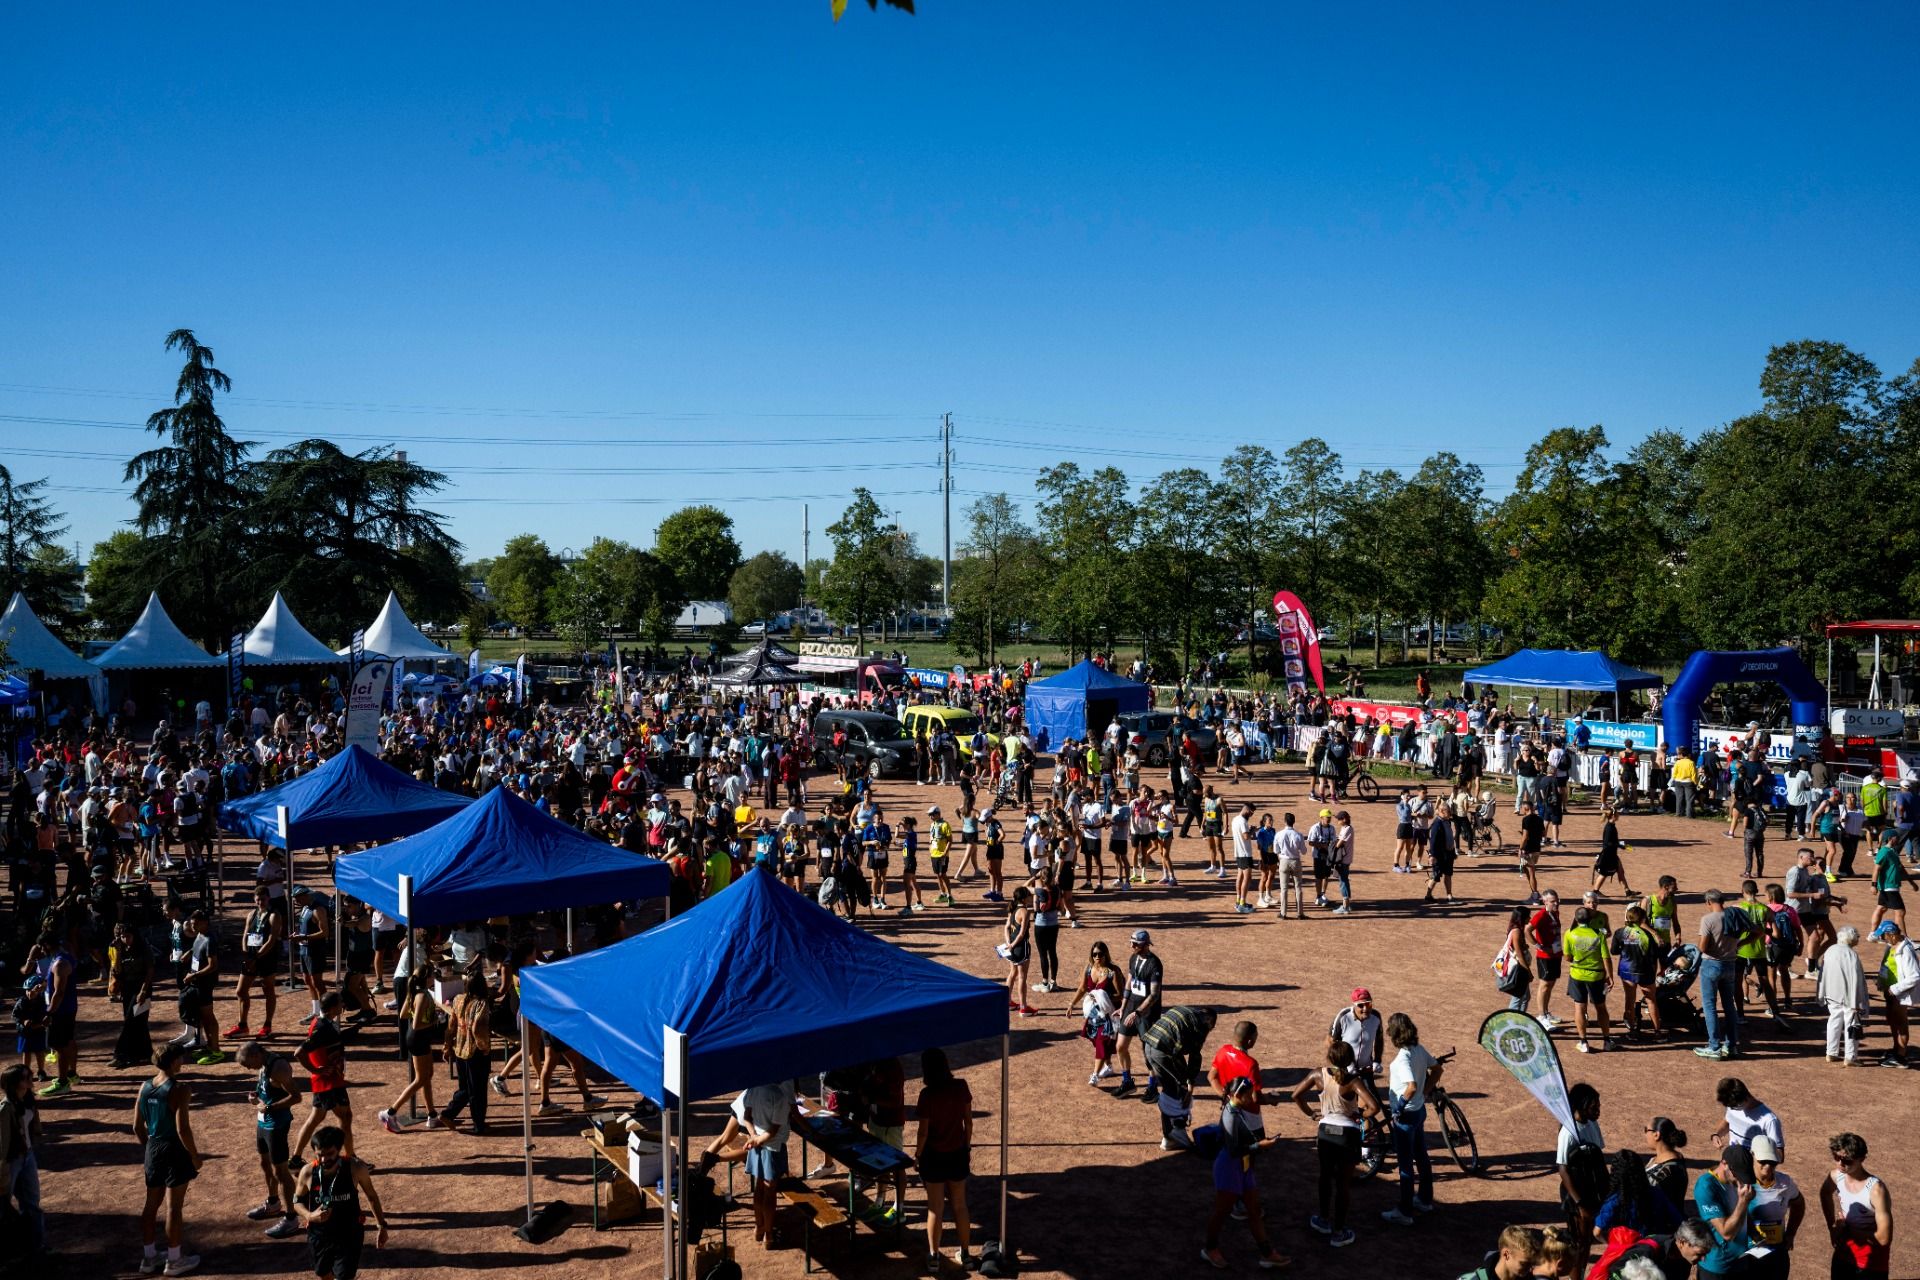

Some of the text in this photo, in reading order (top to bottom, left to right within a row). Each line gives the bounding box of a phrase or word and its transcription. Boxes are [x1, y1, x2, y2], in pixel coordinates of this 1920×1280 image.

[799, 642, 857, 657] PIZZACOSY
[1747, 662, 1778, 671] DECATHLON
[352, 682, 373, 695] Ici
[1843, 715, 1891, 725] LDC LDC
[1591, 725, 1646, 739] La Région
